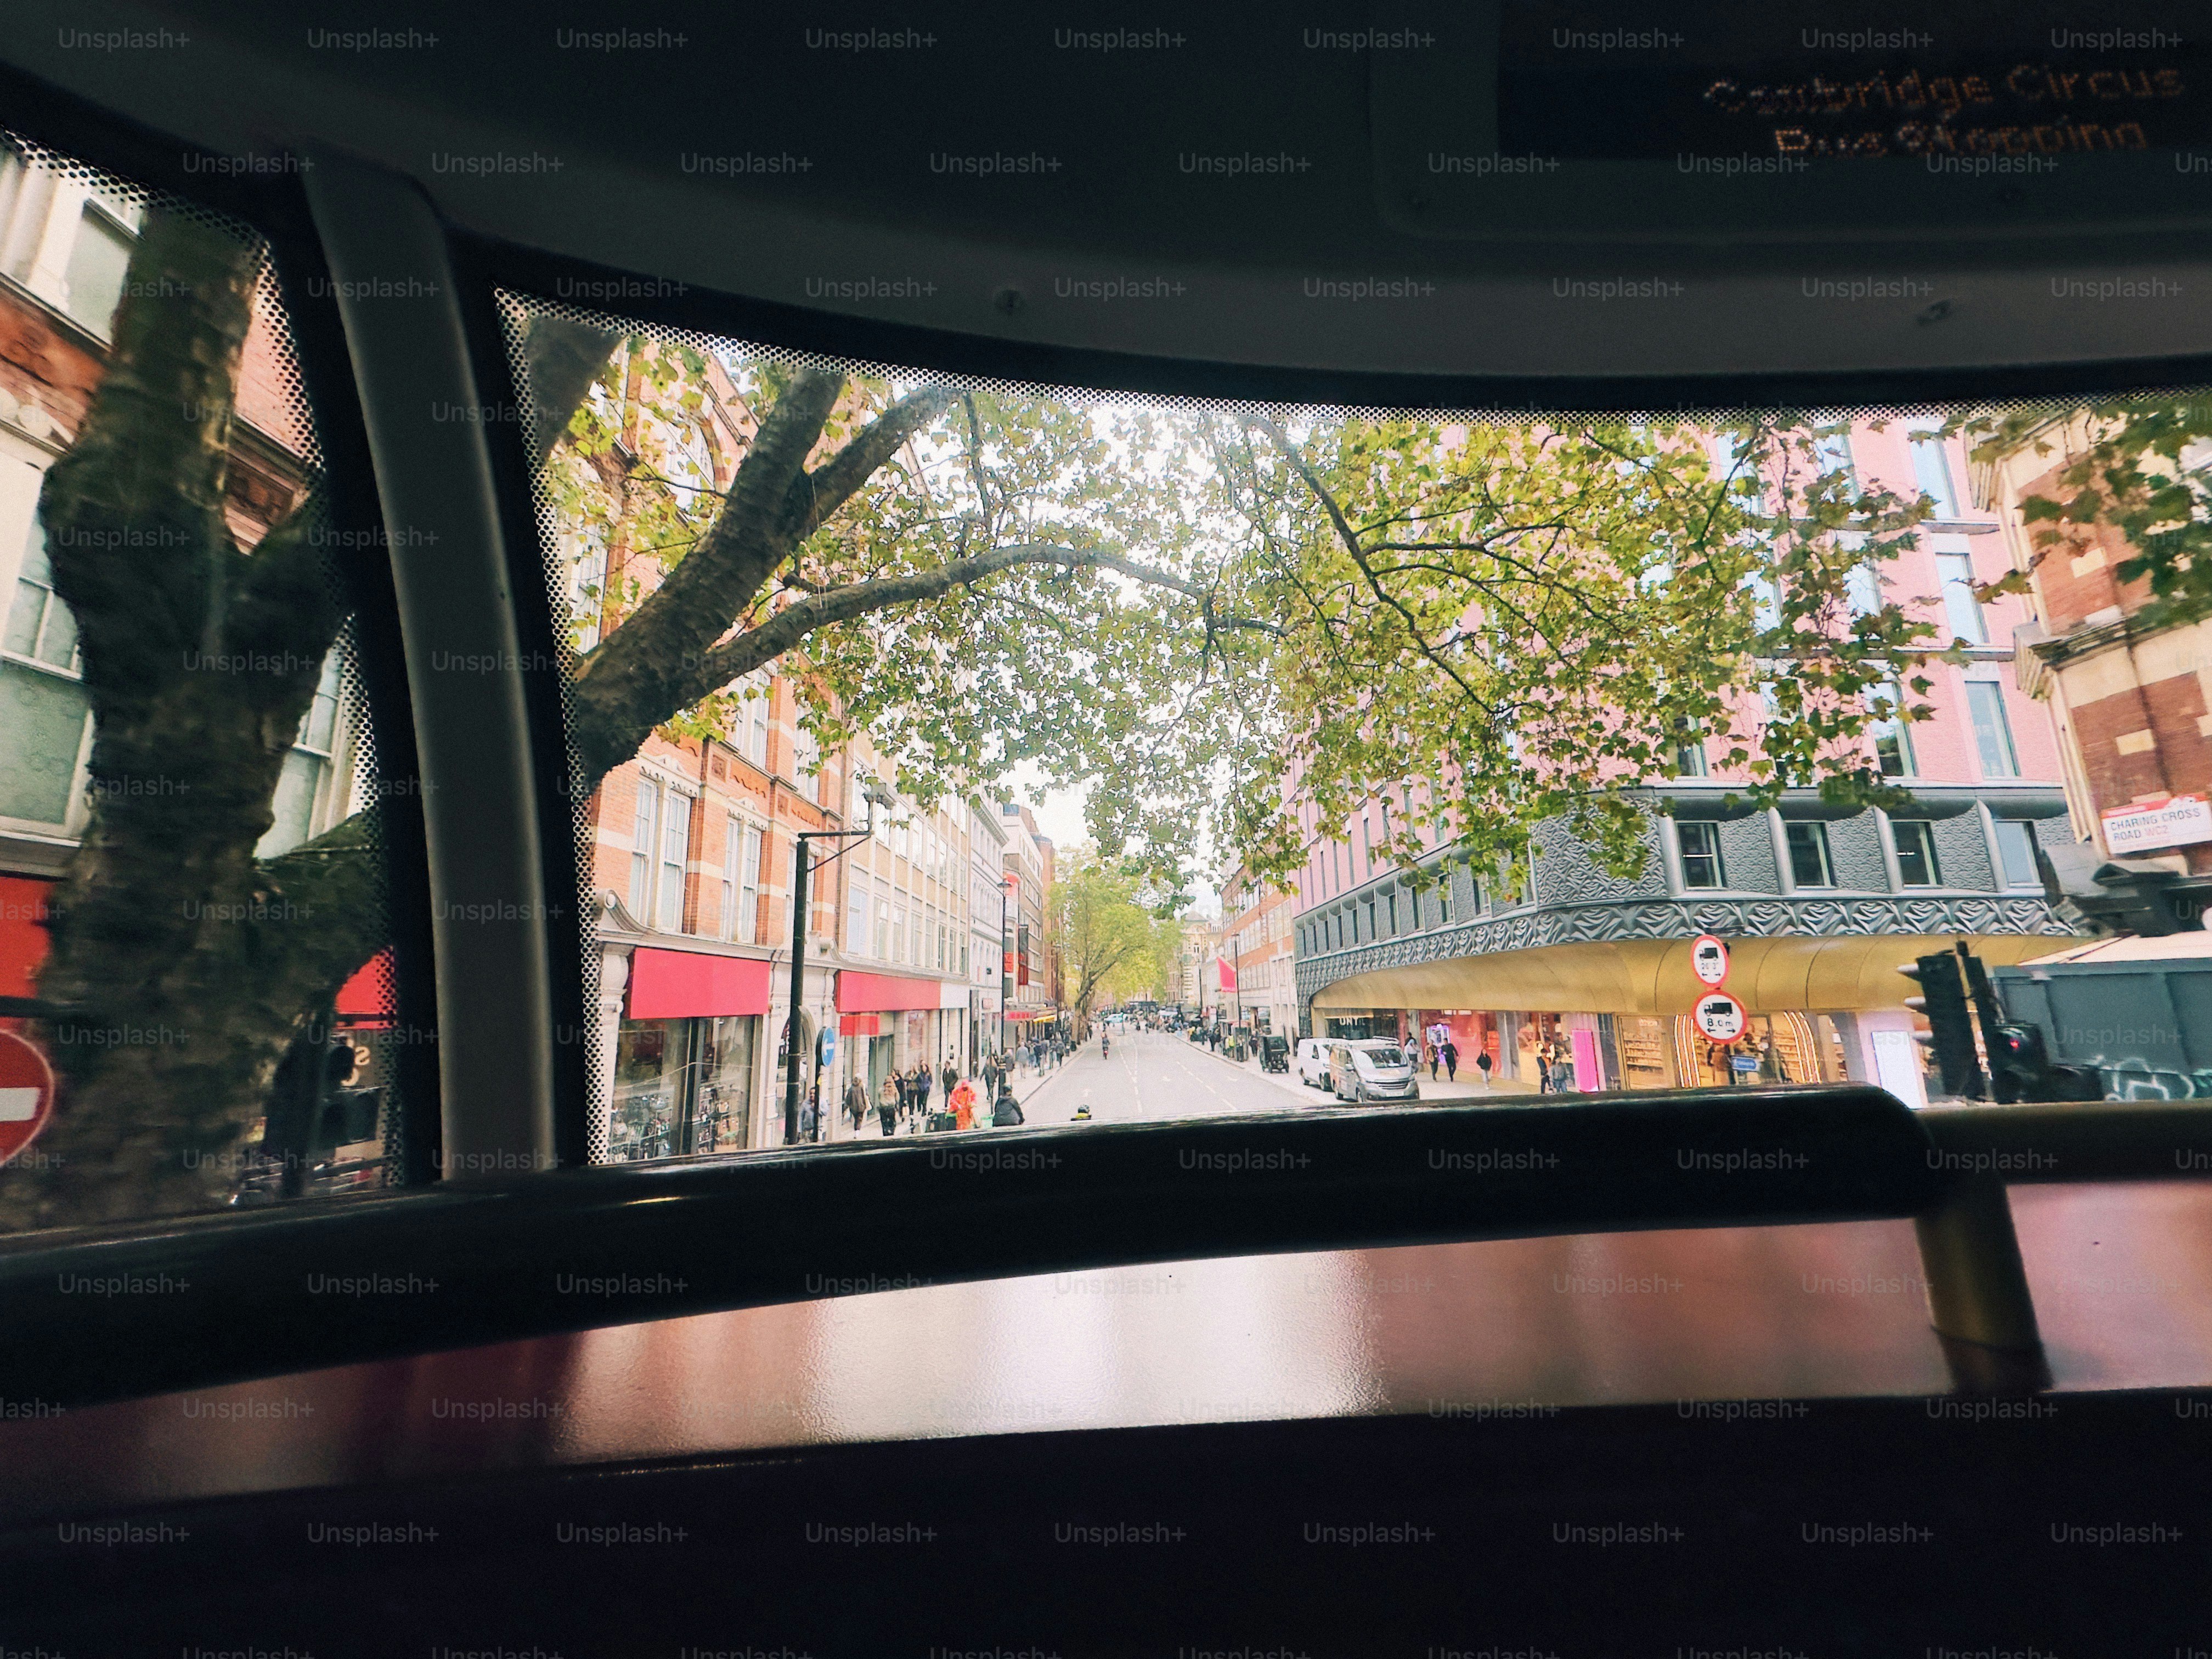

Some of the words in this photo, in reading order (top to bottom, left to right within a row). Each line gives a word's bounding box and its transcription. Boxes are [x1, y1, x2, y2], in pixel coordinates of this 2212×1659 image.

[2006, 64, 2185, 101] Circus
[2110, 815, 2158, 831] CHARING
[2162, 808, 2201, 822] CROSS
[2114, 830, 2141, 841] ROAD
[2145, 825, 2169, 837] WC2
[1339, 1016, 1365, 1026] UNTL
